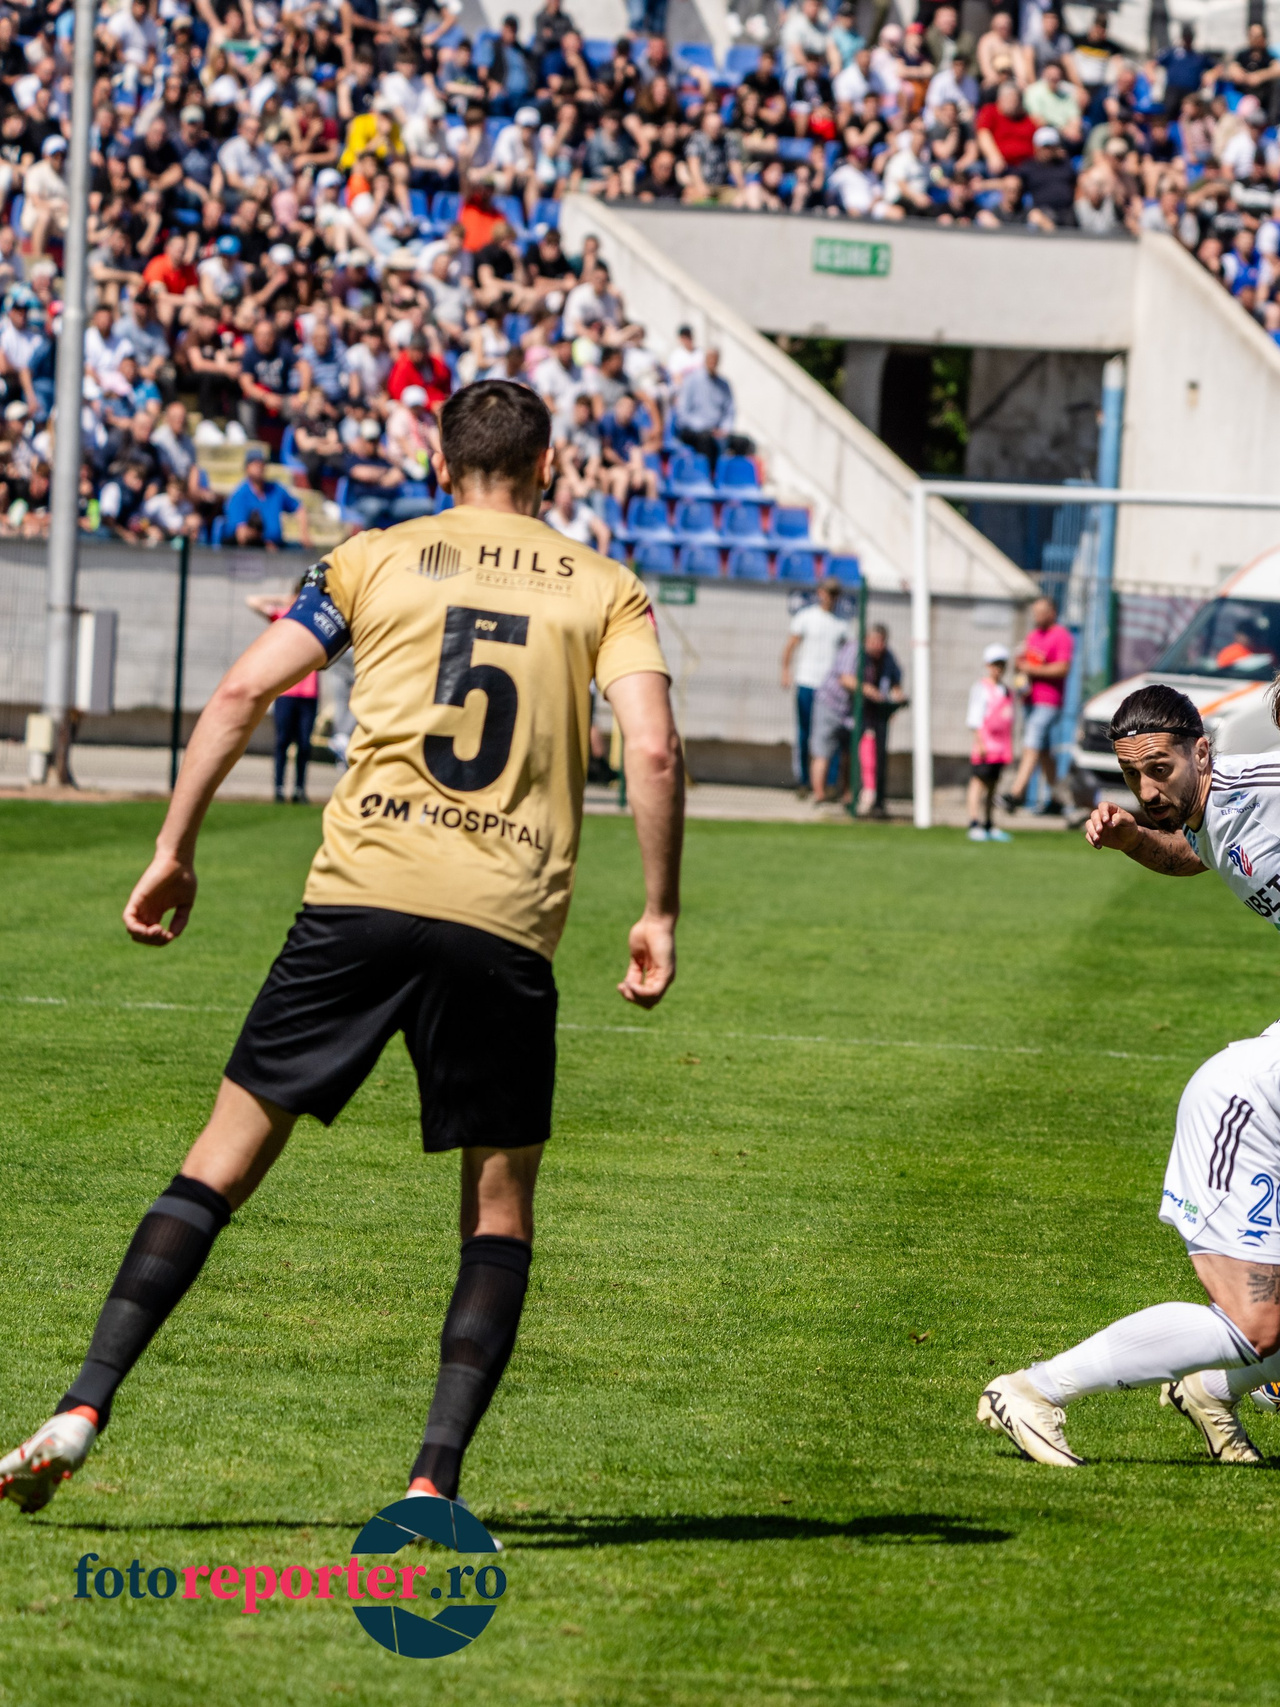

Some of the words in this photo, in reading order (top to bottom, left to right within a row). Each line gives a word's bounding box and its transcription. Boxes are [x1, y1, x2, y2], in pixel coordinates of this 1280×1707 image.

[478, 545, 575, 577] HILS
[475, 573, 573, 593] DEVELOPMENT
[475, 619, 498, 632] FCV
[422, 605, 530, 792] 5
[420, 803, 545, 850] HOSPITAL
